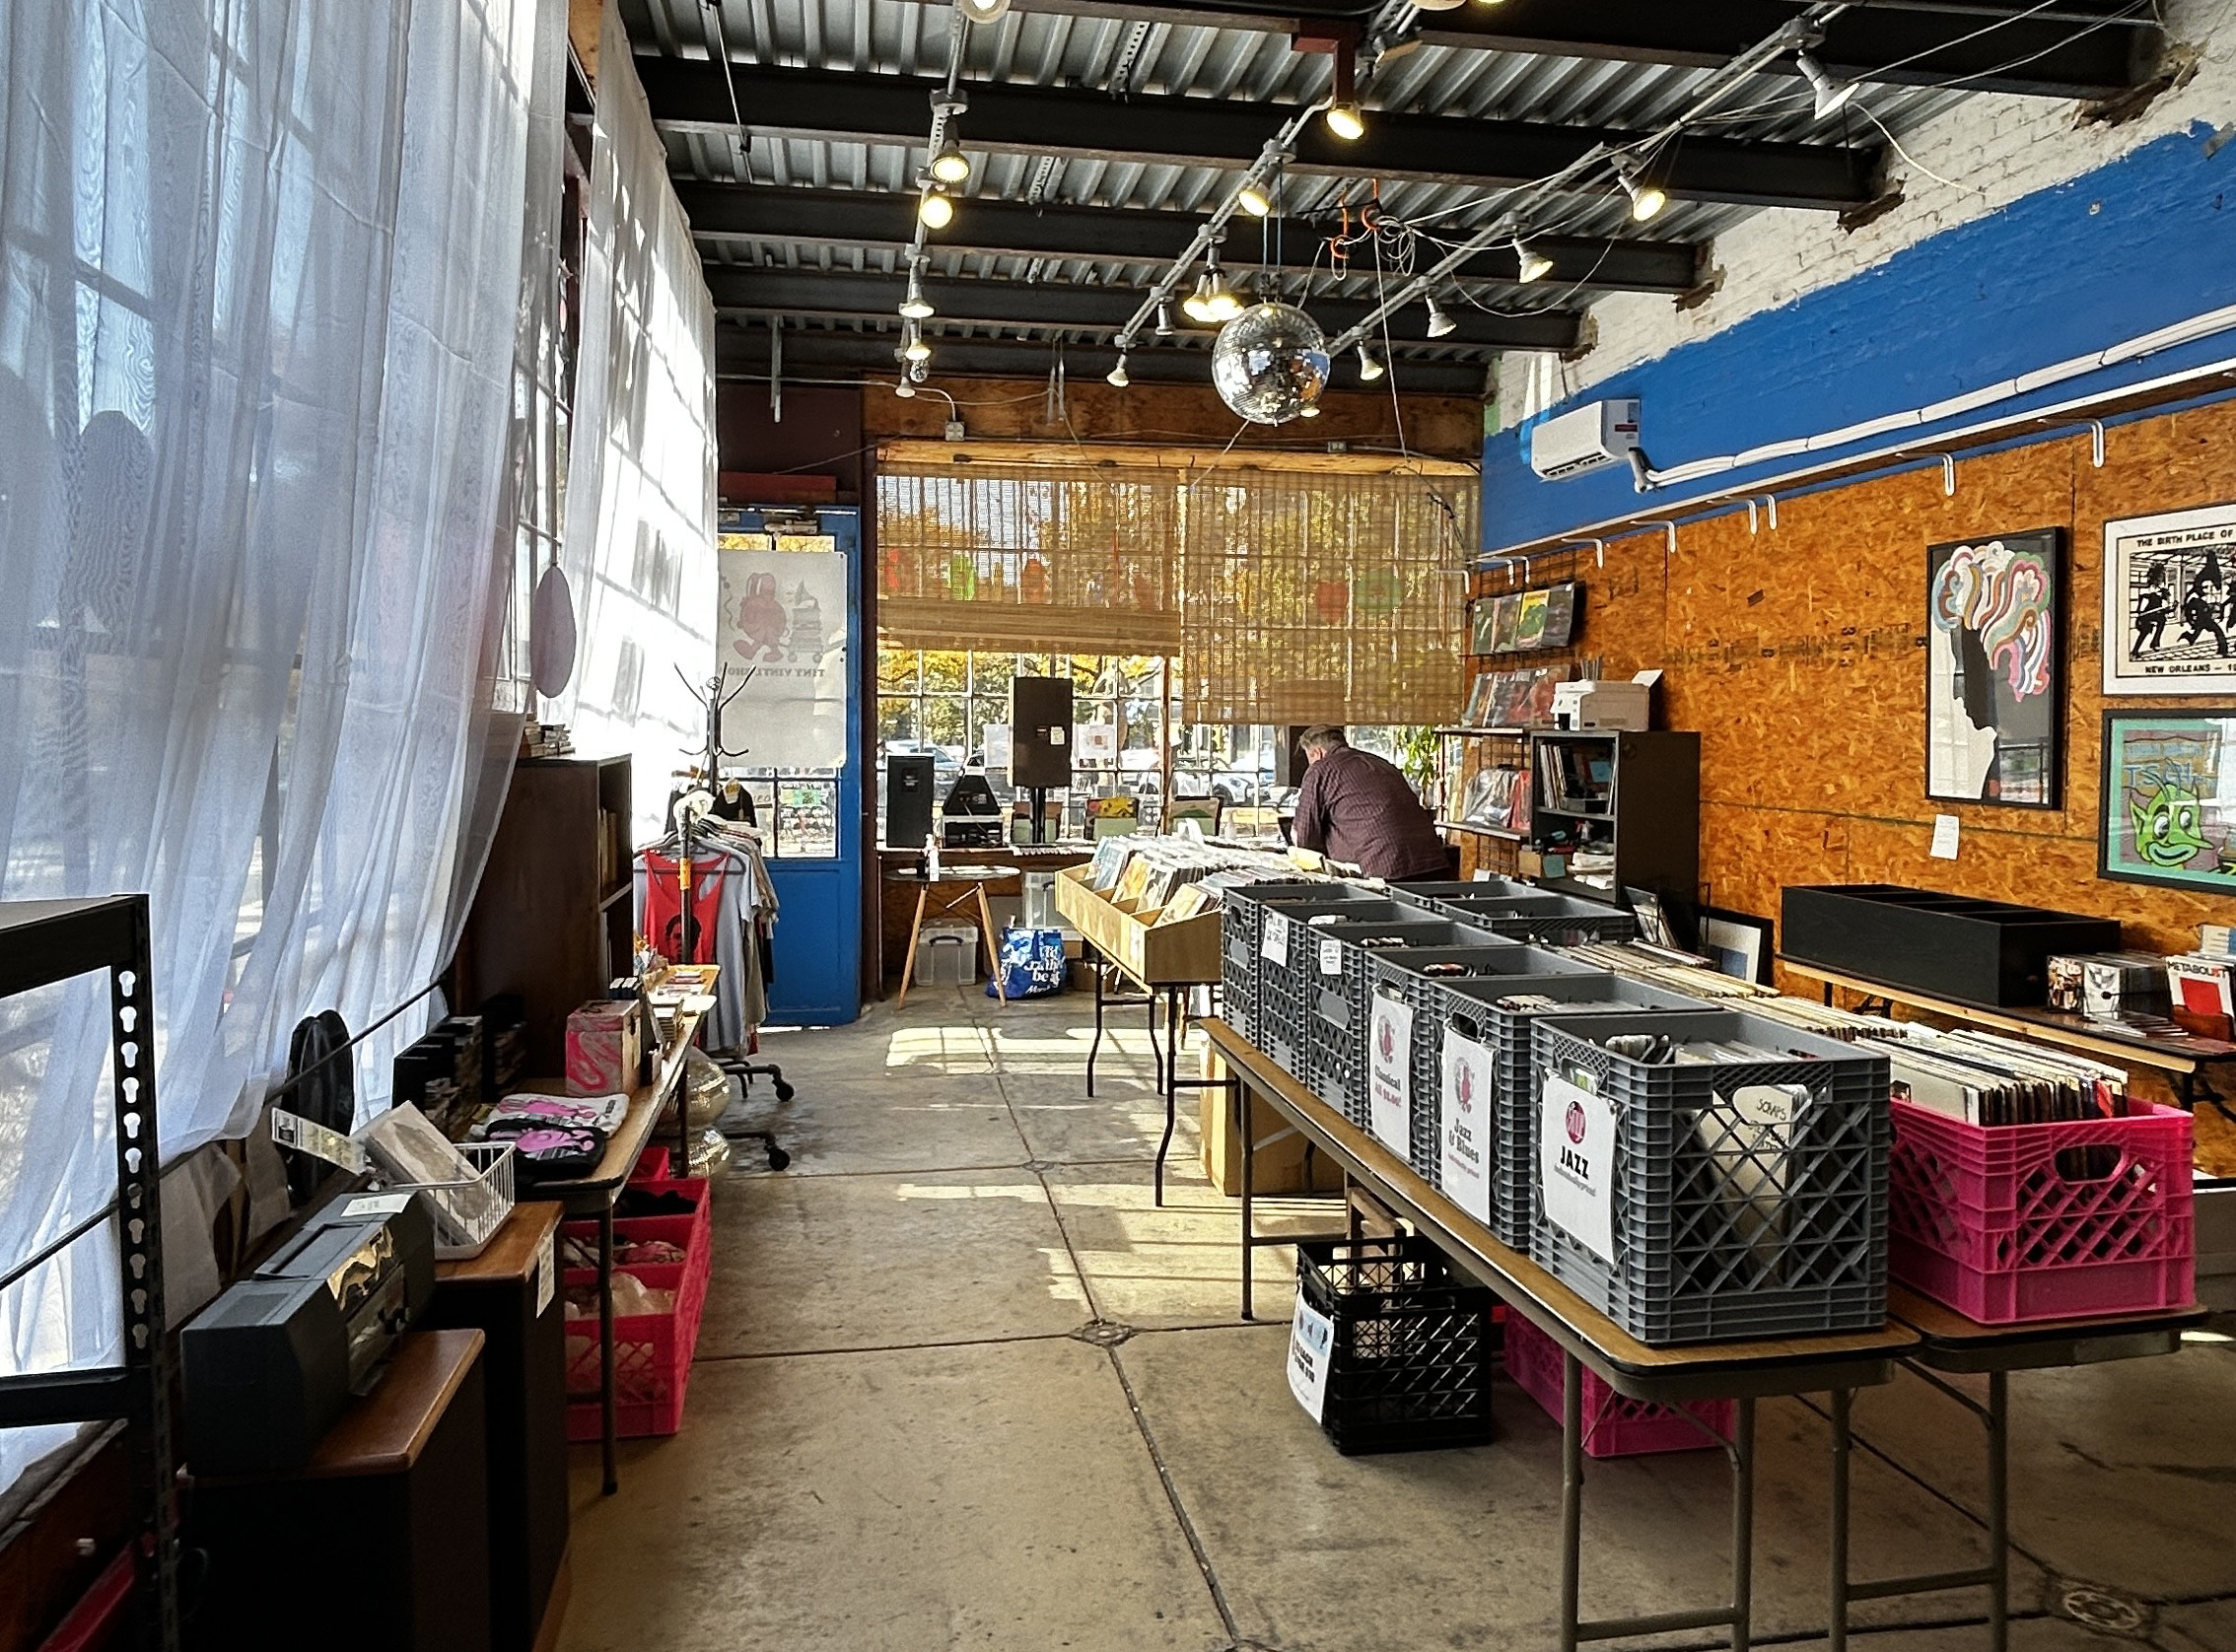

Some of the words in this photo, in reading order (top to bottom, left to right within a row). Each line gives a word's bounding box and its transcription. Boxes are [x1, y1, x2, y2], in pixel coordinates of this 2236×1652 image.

[2136, 538, 2153, 548] THE
[2157, 535, 2183, 547] BIRTH
[2186, 530, 2215, 543] PLACE
[2220, 529, 2233, 538] OF
[2144, 665, 2164, 674] NEW
[2169, 663, 2211, 673] ORLEANS
[1454, 1118, 1472, 1142] Jazz
[1456, 1134, 1480, 1164] Blues
[1560, 1145, 1589, 1181] JAZZ
